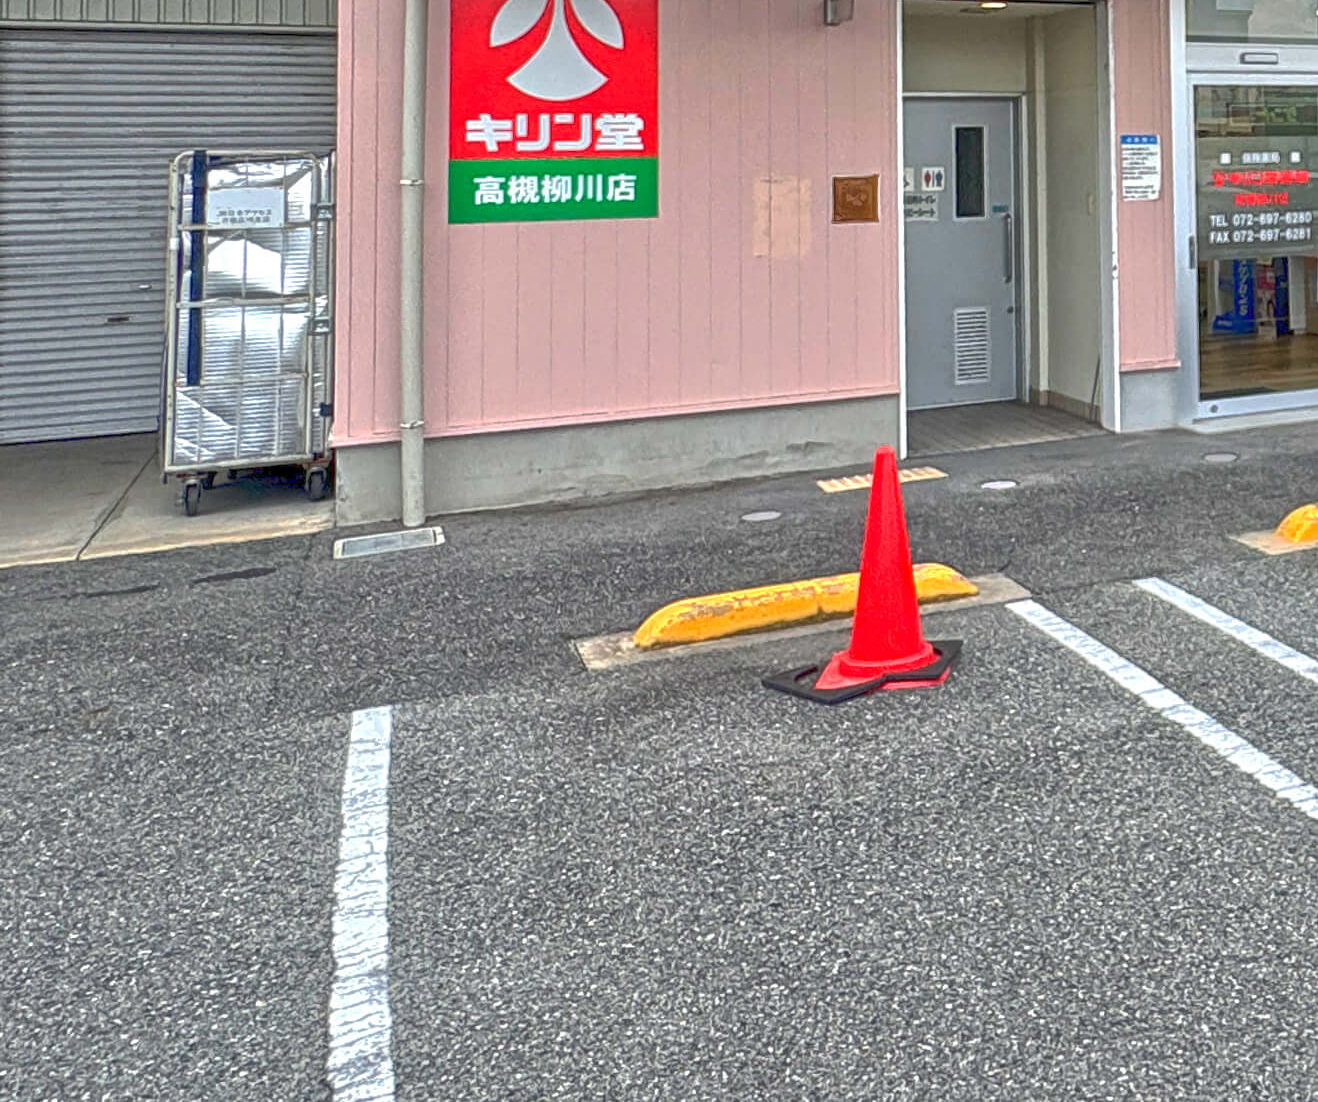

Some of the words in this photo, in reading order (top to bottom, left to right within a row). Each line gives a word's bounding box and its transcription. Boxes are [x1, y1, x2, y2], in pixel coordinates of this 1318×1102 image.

[465, 113, 644, 152] キリン堂
[473, 173, 637, 205] 高槻柳川店
[1210, 215, 1228, 227] TEL
[1210, 231, 1230, 244] FAX
